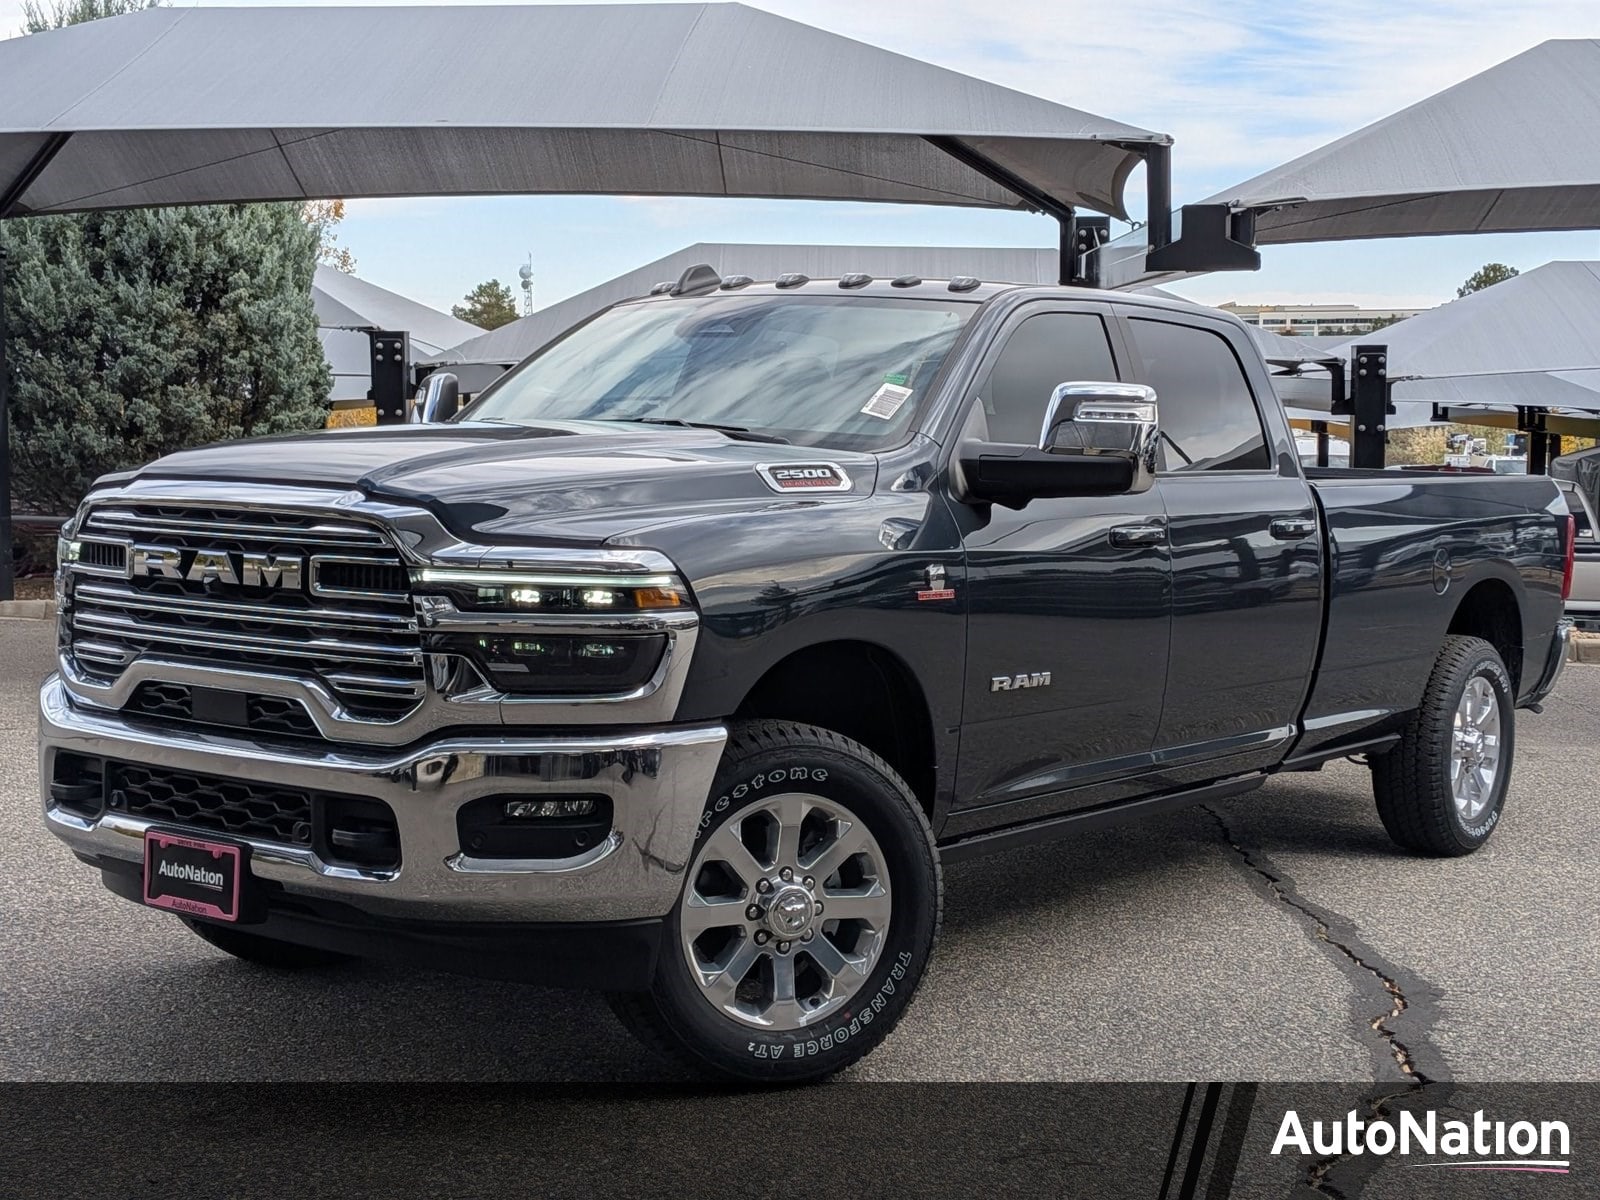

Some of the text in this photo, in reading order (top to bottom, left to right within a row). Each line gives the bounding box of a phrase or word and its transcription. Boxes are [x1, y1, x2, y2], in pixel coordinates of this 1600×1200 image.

[775, 469, 831, 479] 2500
[134, 544, 302, 589] RAM
[991, 671, 1051, 692] RAM
[695, 767, 828, 839] restone
[158, 860, 223, 886] AutoNation
[171, 899, 207, 914] AutoNation
[794, 951, 912, 1058] TRANSFORCE
